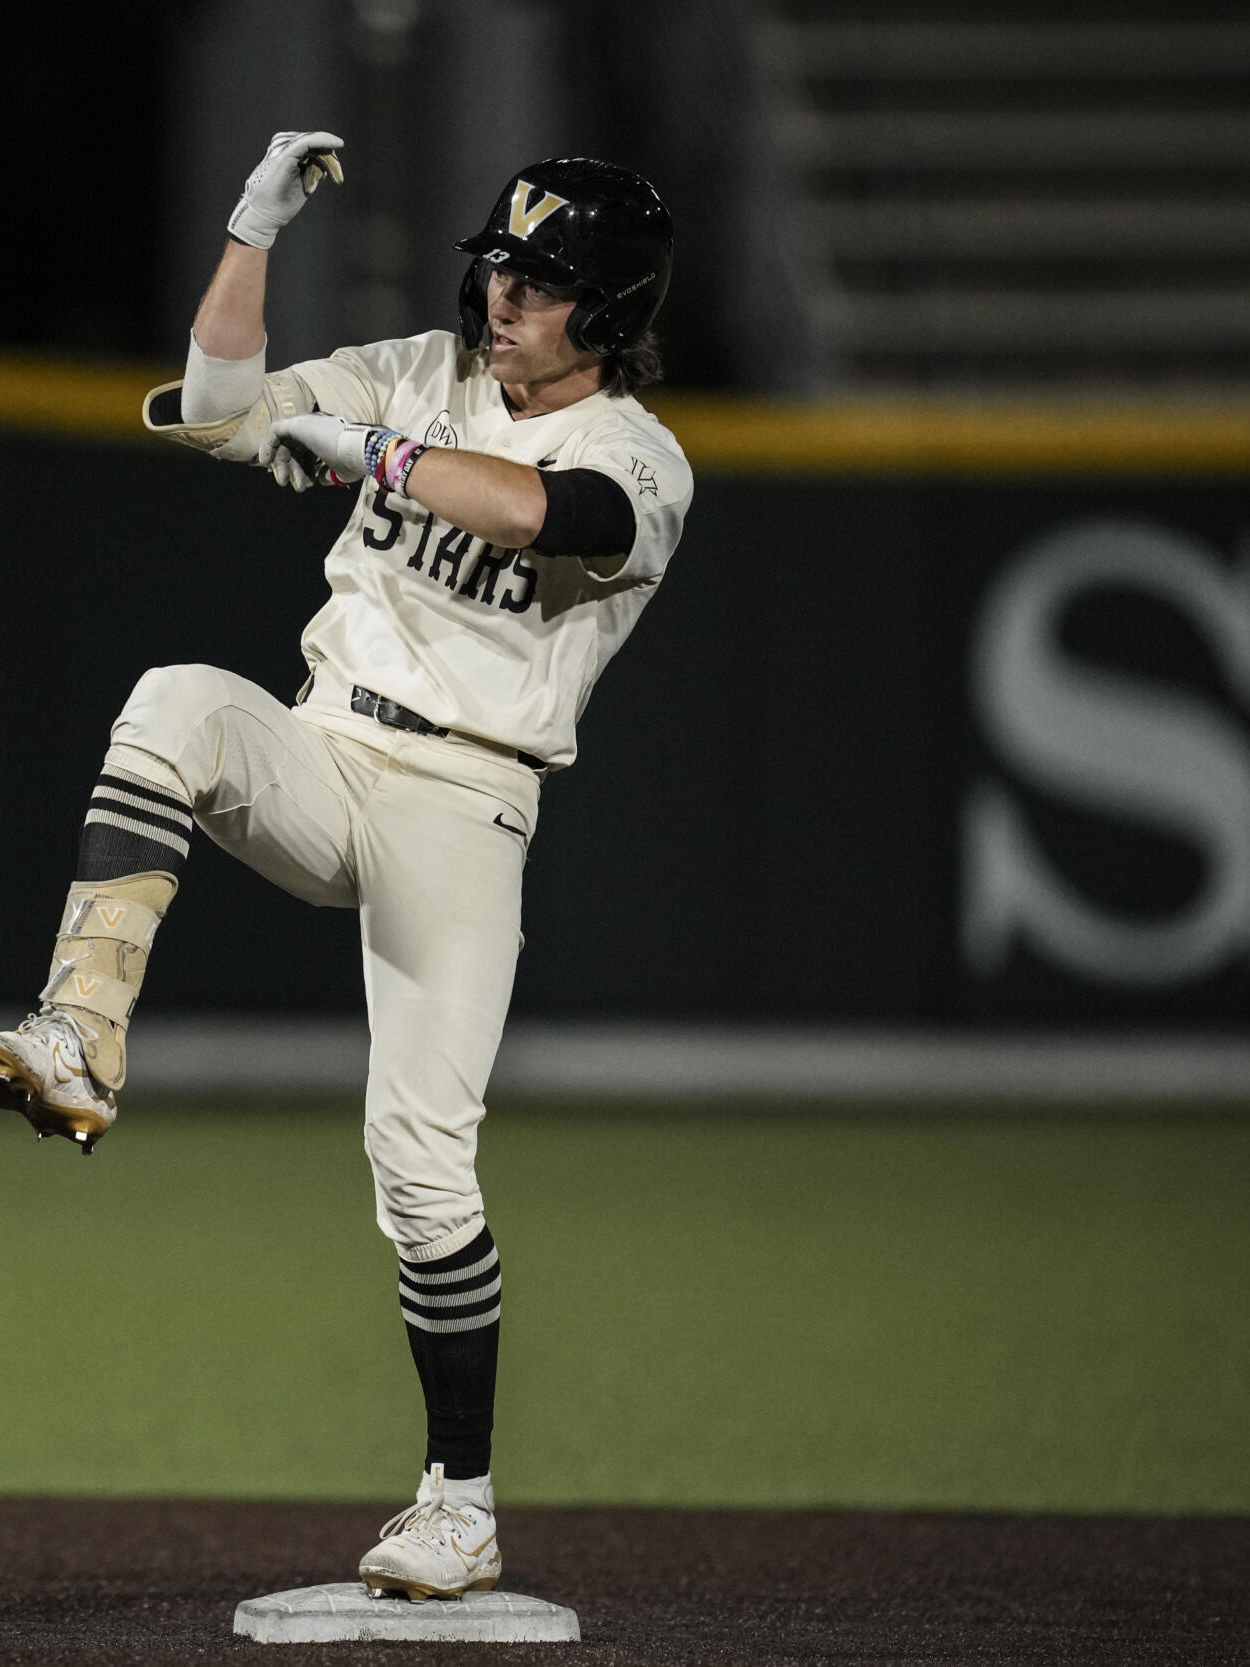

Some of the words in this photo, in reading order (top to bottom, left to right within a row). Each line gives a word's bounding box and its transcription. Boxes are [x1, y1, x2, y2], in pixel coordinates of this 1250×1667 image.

[508, 179, 570, 240] V
[482, 249, 511, 263] 13
[430, 420, 453, 446] DW
[960, 515, 1250, 985] S
[96, 907, 127, 929] V
[73, 974, 103, 998] V
